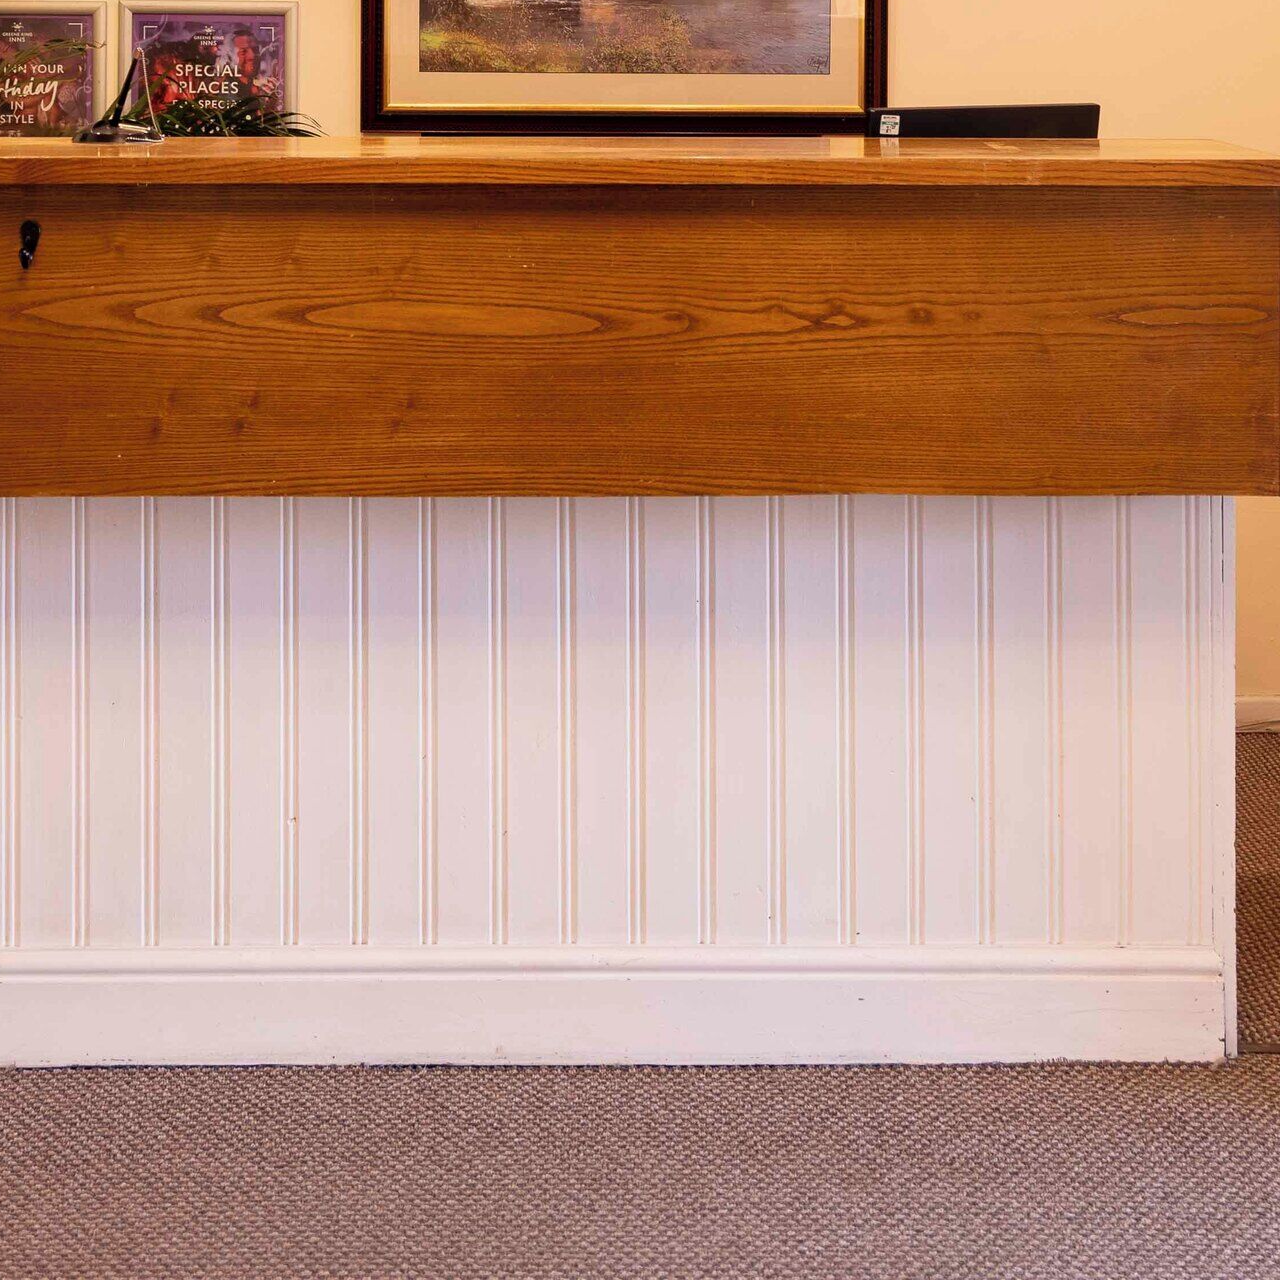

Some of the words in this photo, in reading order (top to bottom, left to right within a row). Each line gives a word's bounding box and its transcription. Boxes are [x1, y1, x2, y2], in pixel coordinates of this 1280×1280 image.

[30, 64, 64, 73] YOUR
[175, 64, 242, 77] SPECIAL
[179, 81, 239, 94] PLACES
[10, 101, 24, 110] IN
[0, 114, 34, 124] STYLE
